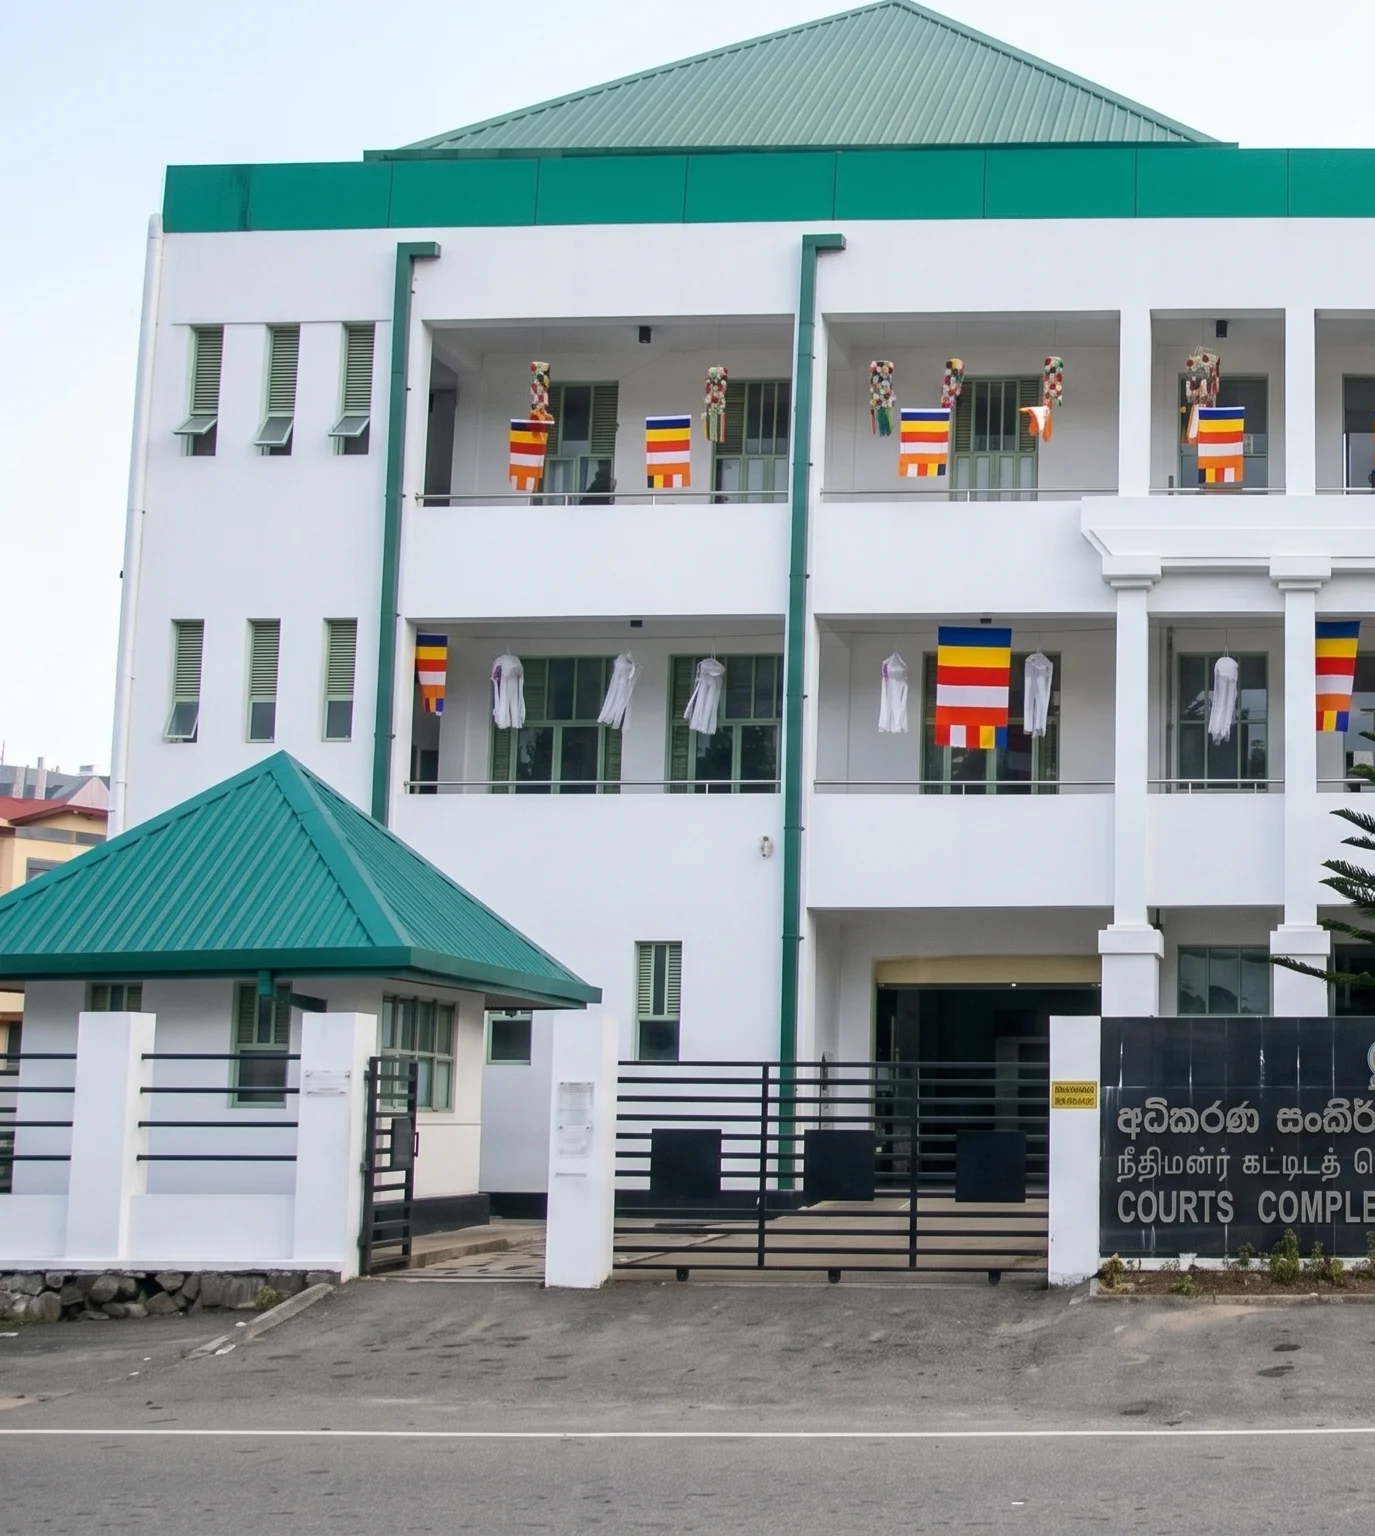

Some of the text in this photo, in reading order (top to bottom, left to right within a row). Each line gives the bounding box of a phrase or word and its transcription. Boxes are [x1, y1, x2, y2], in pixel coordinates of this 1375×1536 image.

[1117, 1096, 1260, 1140] අධිකරණ
[1242, 1146, 1341, 1182] கட்டிடத்
[1117, 1190, 1234, 1224] COURTS
